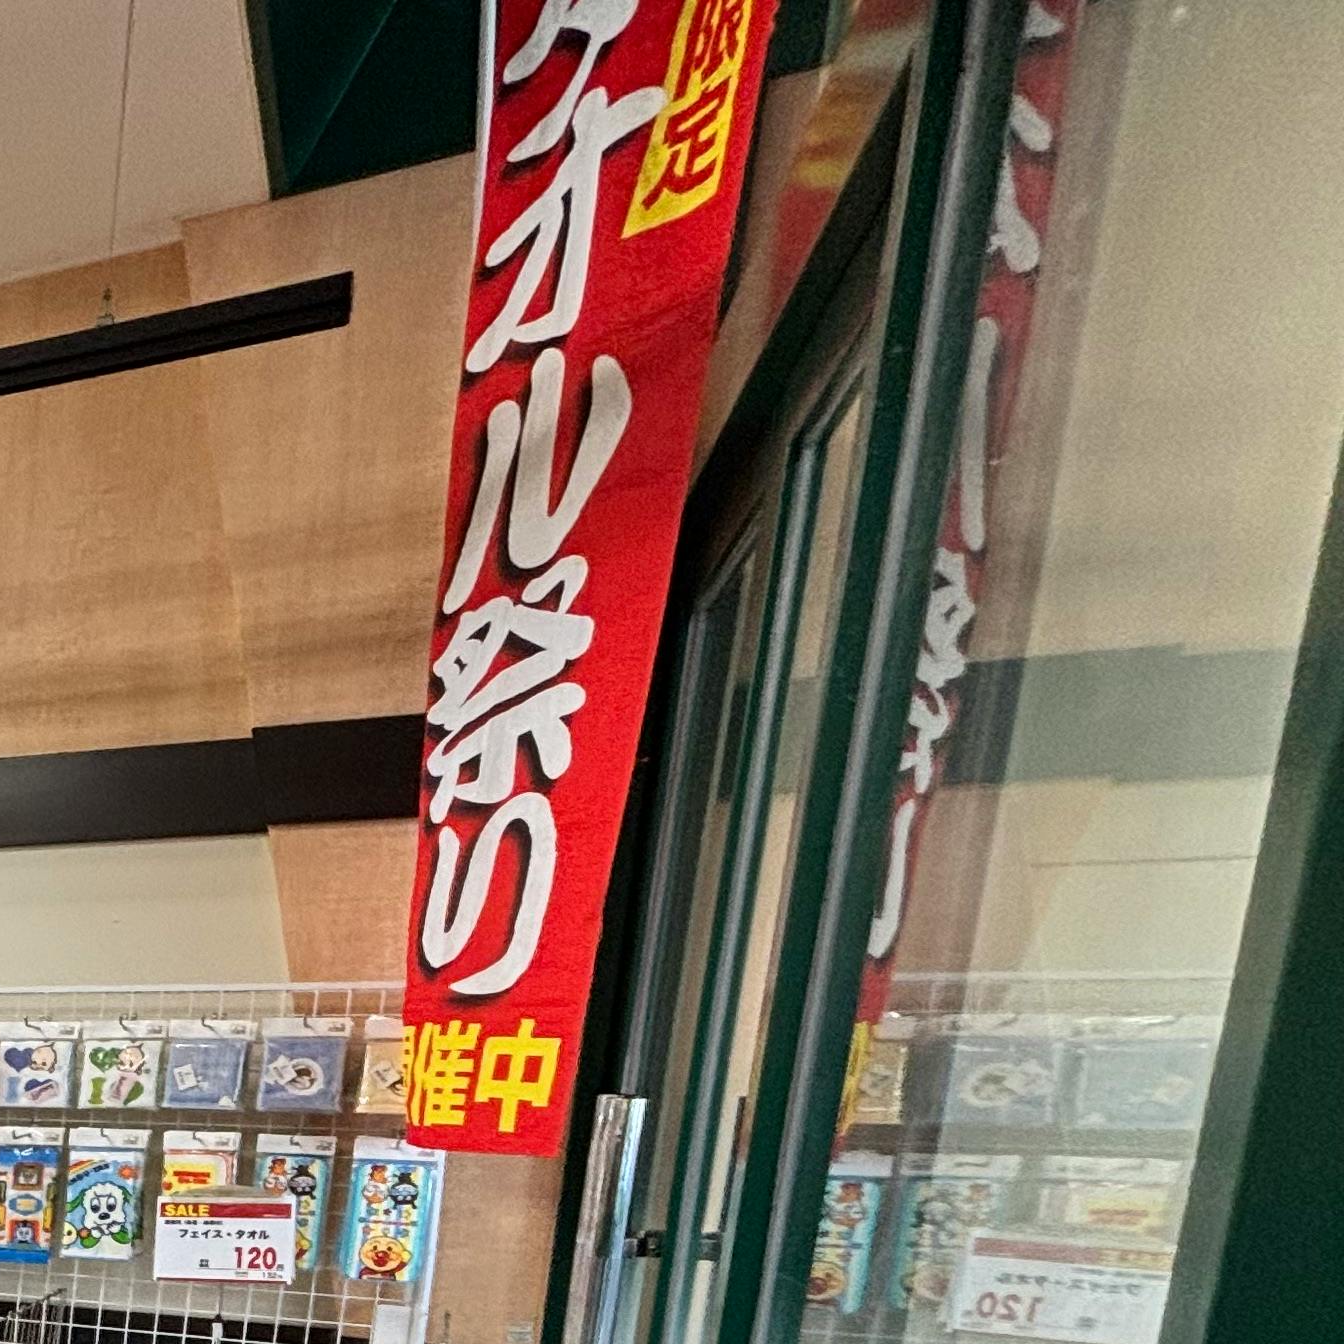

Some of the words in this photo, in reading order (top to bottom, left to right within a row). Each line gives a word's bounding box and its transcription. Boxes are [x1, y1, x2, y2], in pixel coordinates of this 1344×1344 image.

[165, 1204, 210, 1217] SALE
[178, 1229, 270, 1240] フェイス・タオル
